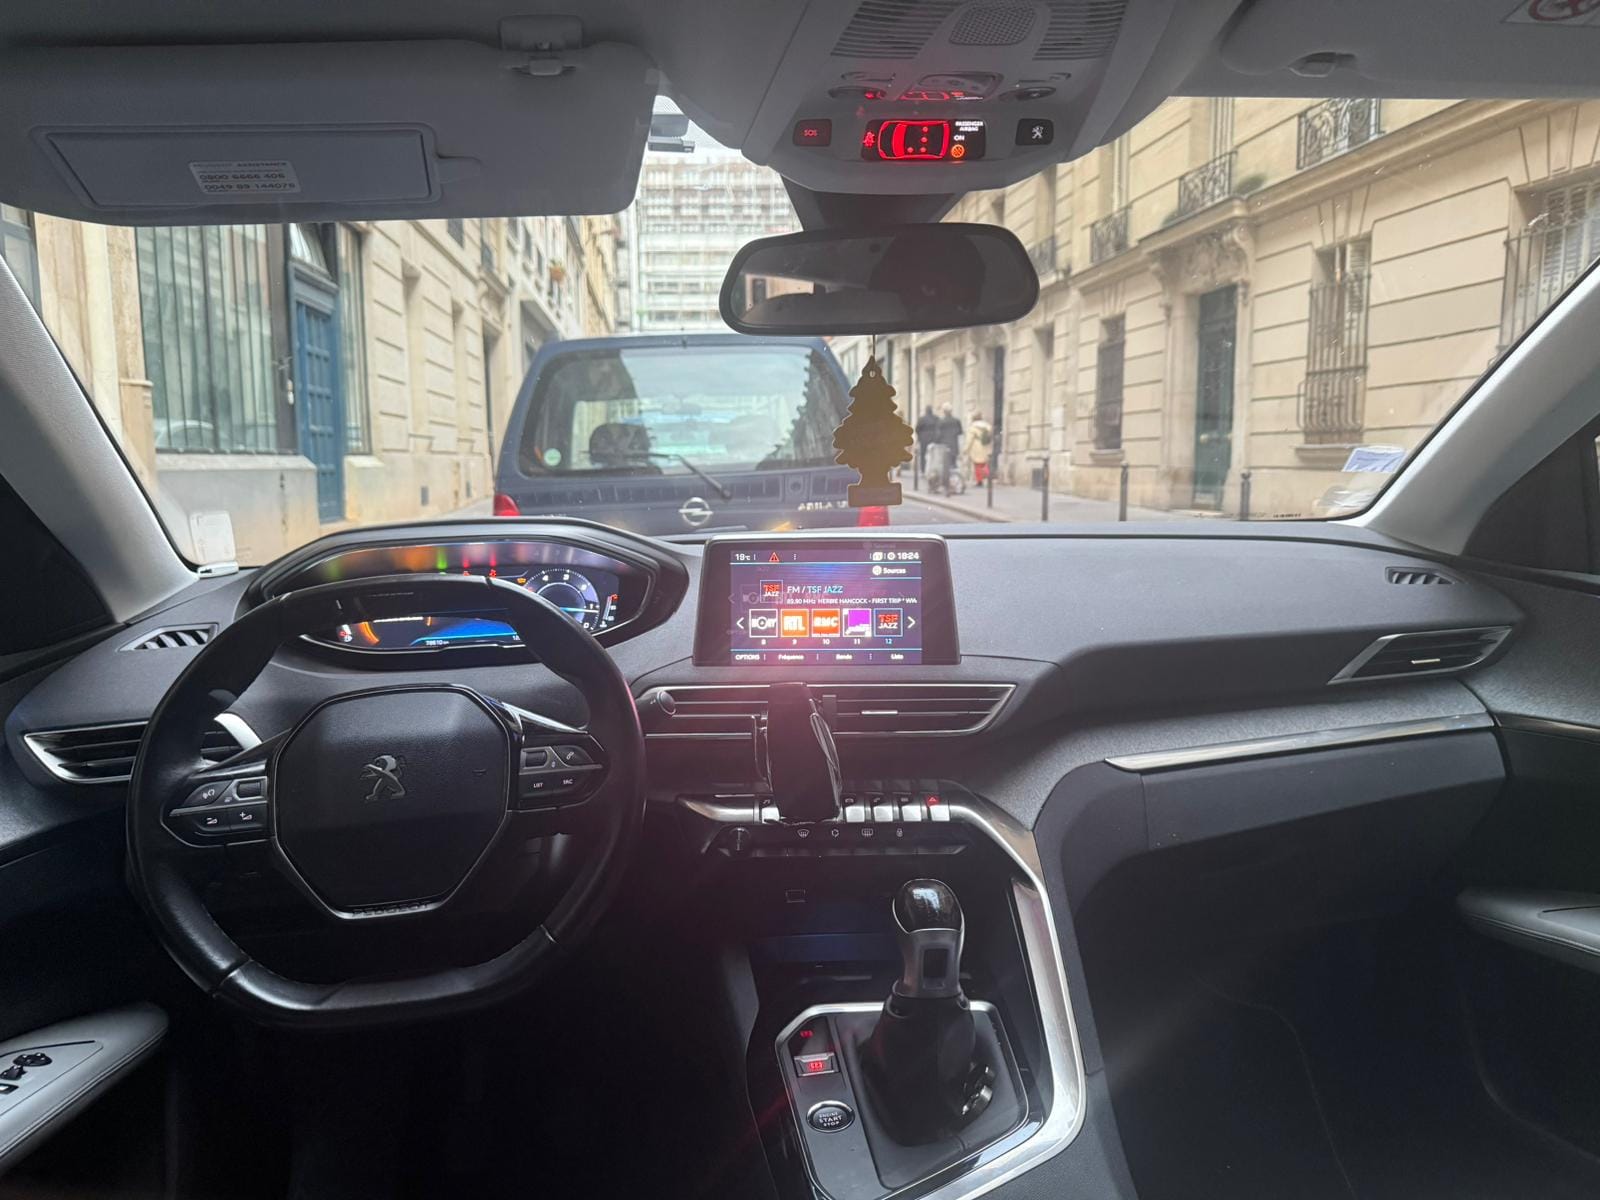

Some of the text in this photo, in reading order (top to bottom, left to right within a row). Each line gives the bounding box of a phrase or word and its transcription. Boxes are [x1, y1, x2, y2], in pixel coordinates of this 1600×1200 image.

[804, 129, 818, 137] SOS
[542, 574, 549, 582] 4
[763, 584, 780, 592] TSF
[786, 585, 800, 594] FM
[806, 585, 822, 593] TSF
[823, 585, 844, 593] JAZZ
[814, 616, 838, 627] RMC
[877, 614, 899, 622] TSF
[783, 615, 806, 631] RTL
[819, 1115, 842, 1123] START
